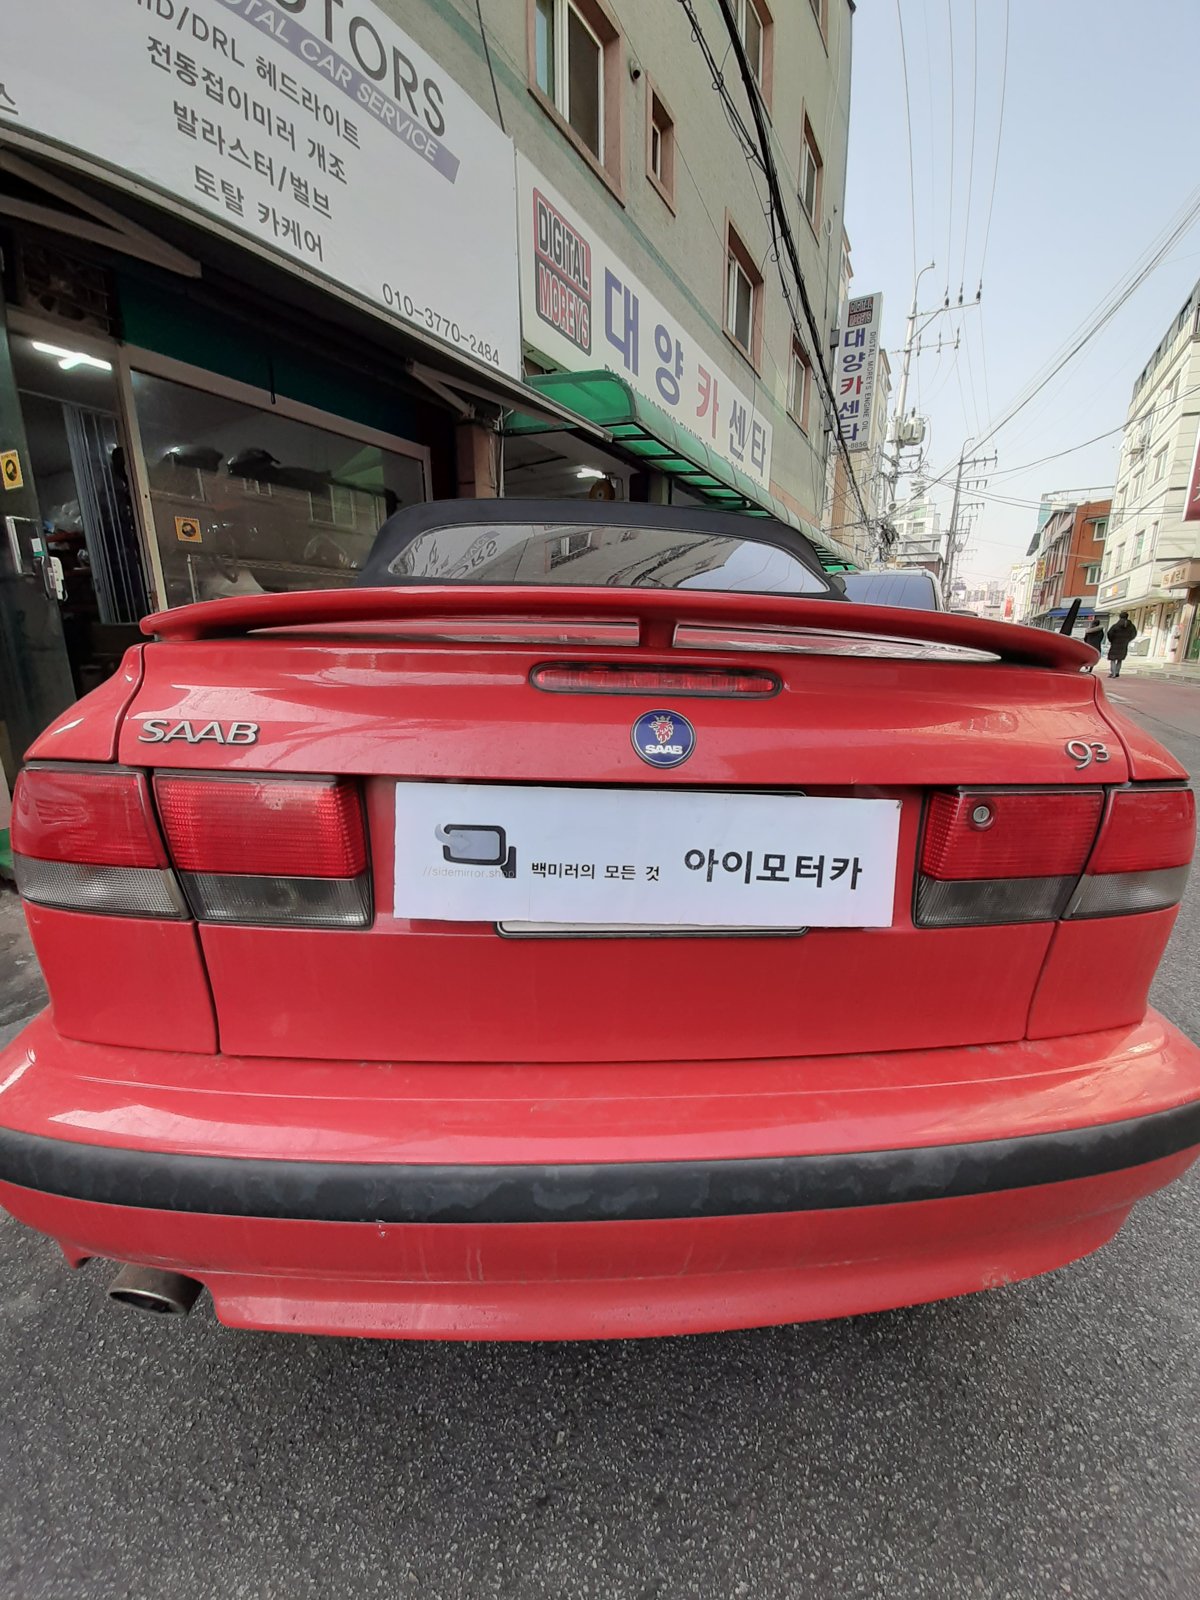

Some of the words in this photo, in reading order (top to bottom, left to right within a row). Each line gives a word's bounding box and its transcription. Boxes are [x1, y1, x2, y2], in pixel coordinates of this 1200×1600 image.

[147, 35, 296, 152] 전동접이미러
[307, 138, 348, 185] 개조
[255, 55, 361, 150] 헤드라이트
[274, 0, 446, 137] TORS
[301, 39, 353, 88] CAR
[357, 82, 439, 162] SERVICE
[173, 99, 333, 220] 발라스터/벌브
[194, 164, 245, 218] 토탈
[257, 201, 324, 263] 카케어
[537, 197, 590, 293] DIGITAL
[382, 283, 500, 366] 010-3770-2484
[539, 262, 590, 350] MOREYS
[861, 420, 869, 432] OIL
[862, 392, 872, 419] ENGINE
[138, 719, 259, 745] SAAB
[645, 744, 683, 755] SAAB
[1065, 740, 1110, 770] 93
[531, 862, 596, 880] 백미러의
[604, 865, 637, 881] 모든
[645, 866, 660, 882] 것
[684, 848, 863, 890] 아이모터카
